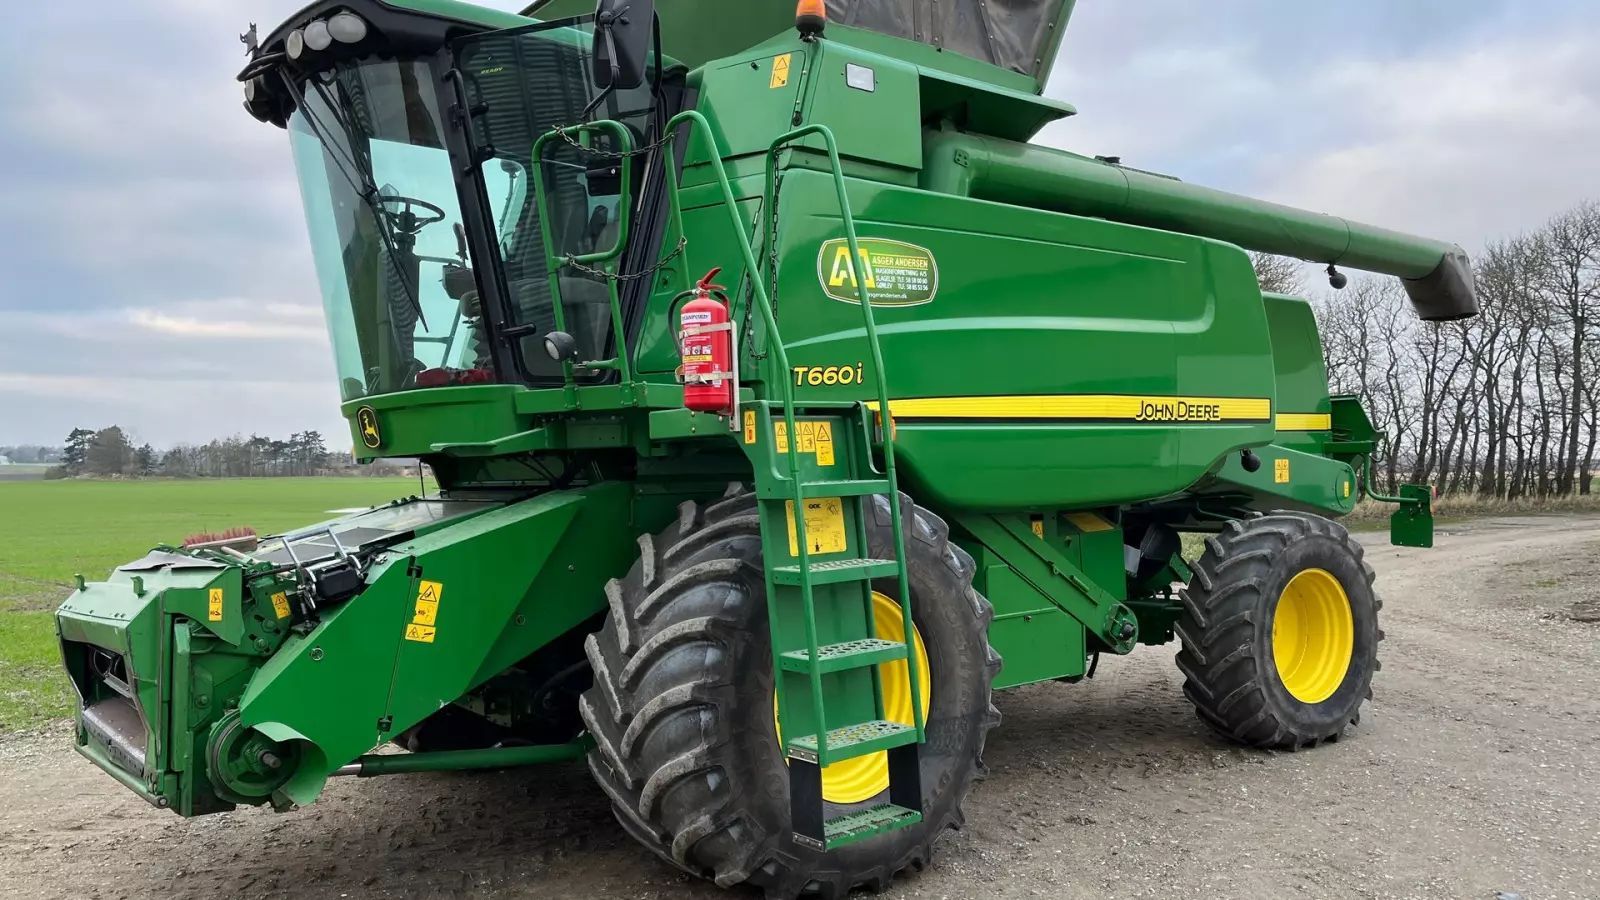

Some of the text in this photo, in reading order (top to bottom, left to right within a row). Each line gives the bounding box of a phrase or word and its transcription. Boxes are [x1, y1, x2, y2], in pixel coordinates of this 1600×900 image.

[872, 256, 928, 268] ASGER ANDERSEN
[794, 361, 863, 386] T660i
[1135, 399, 1220, 419] JOHN DEERE
